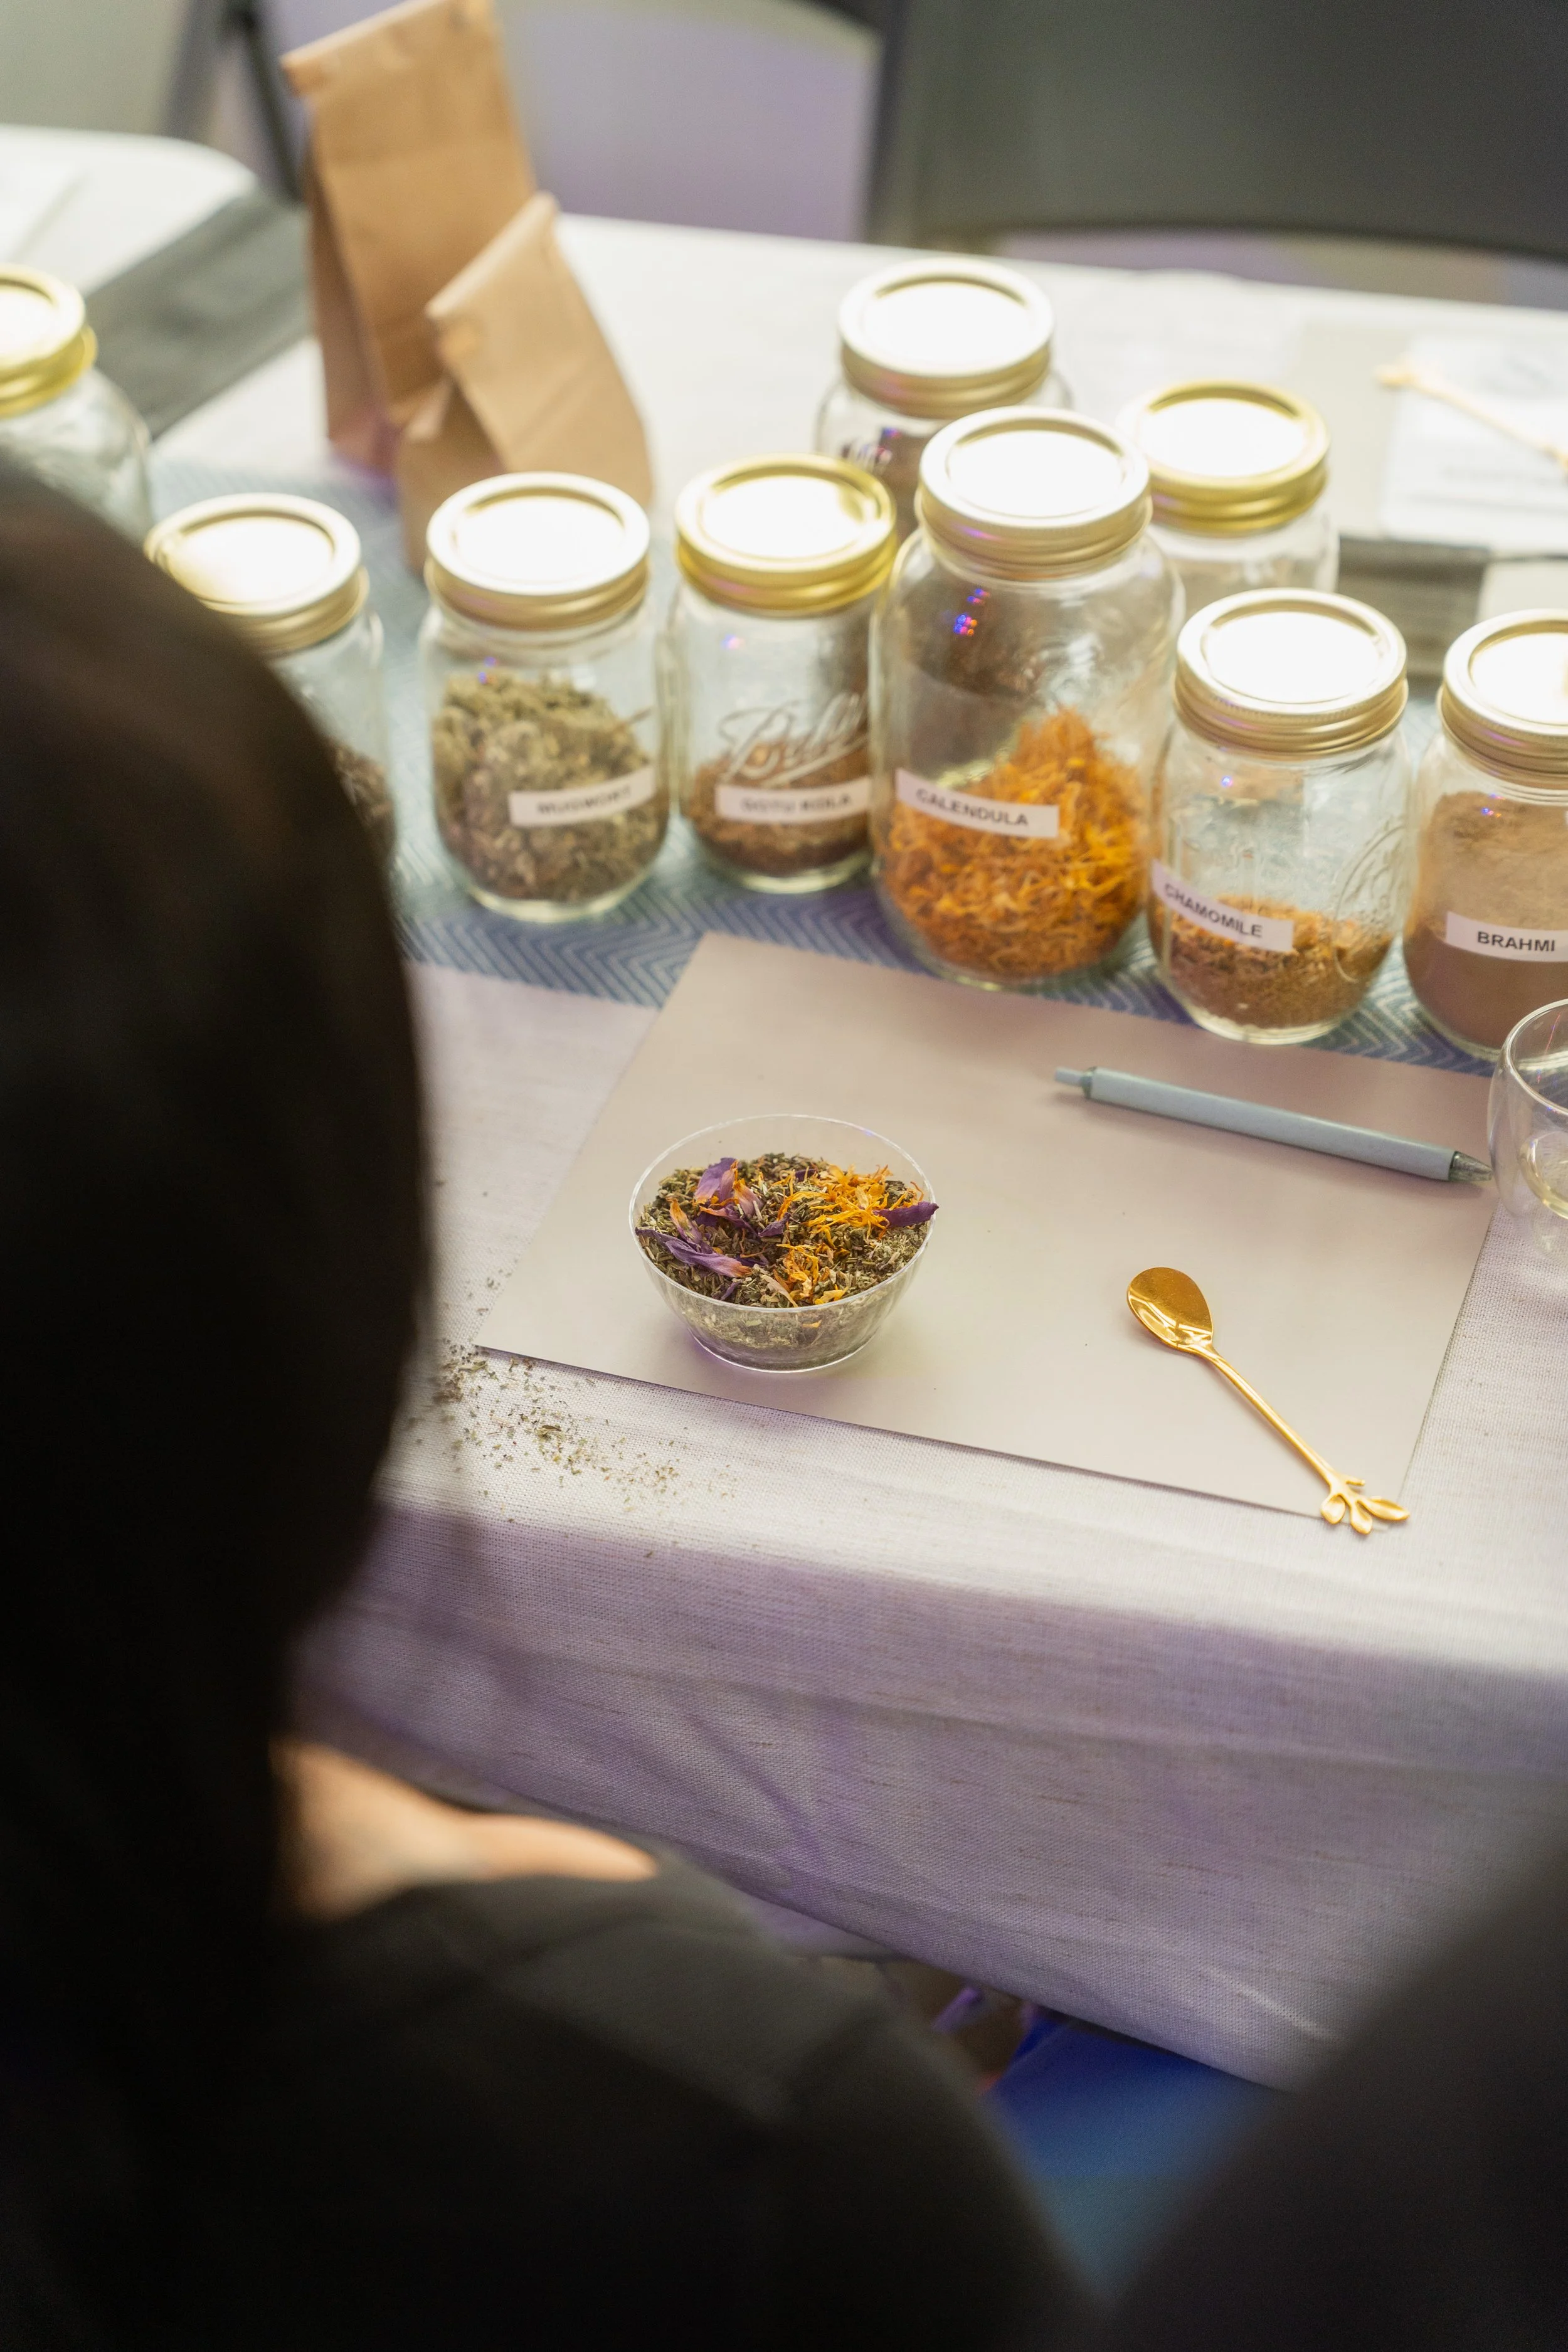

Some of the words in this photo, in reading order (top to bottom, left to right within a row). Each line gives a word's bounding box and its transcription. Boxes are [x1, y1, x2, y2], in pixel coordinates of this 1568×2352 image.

[915, 787, 1029, 827] CALENDULA
[1164, 882, 1263, 938] CHAMOMILE
[1477, 930, 1555, 952] BRAHMI
